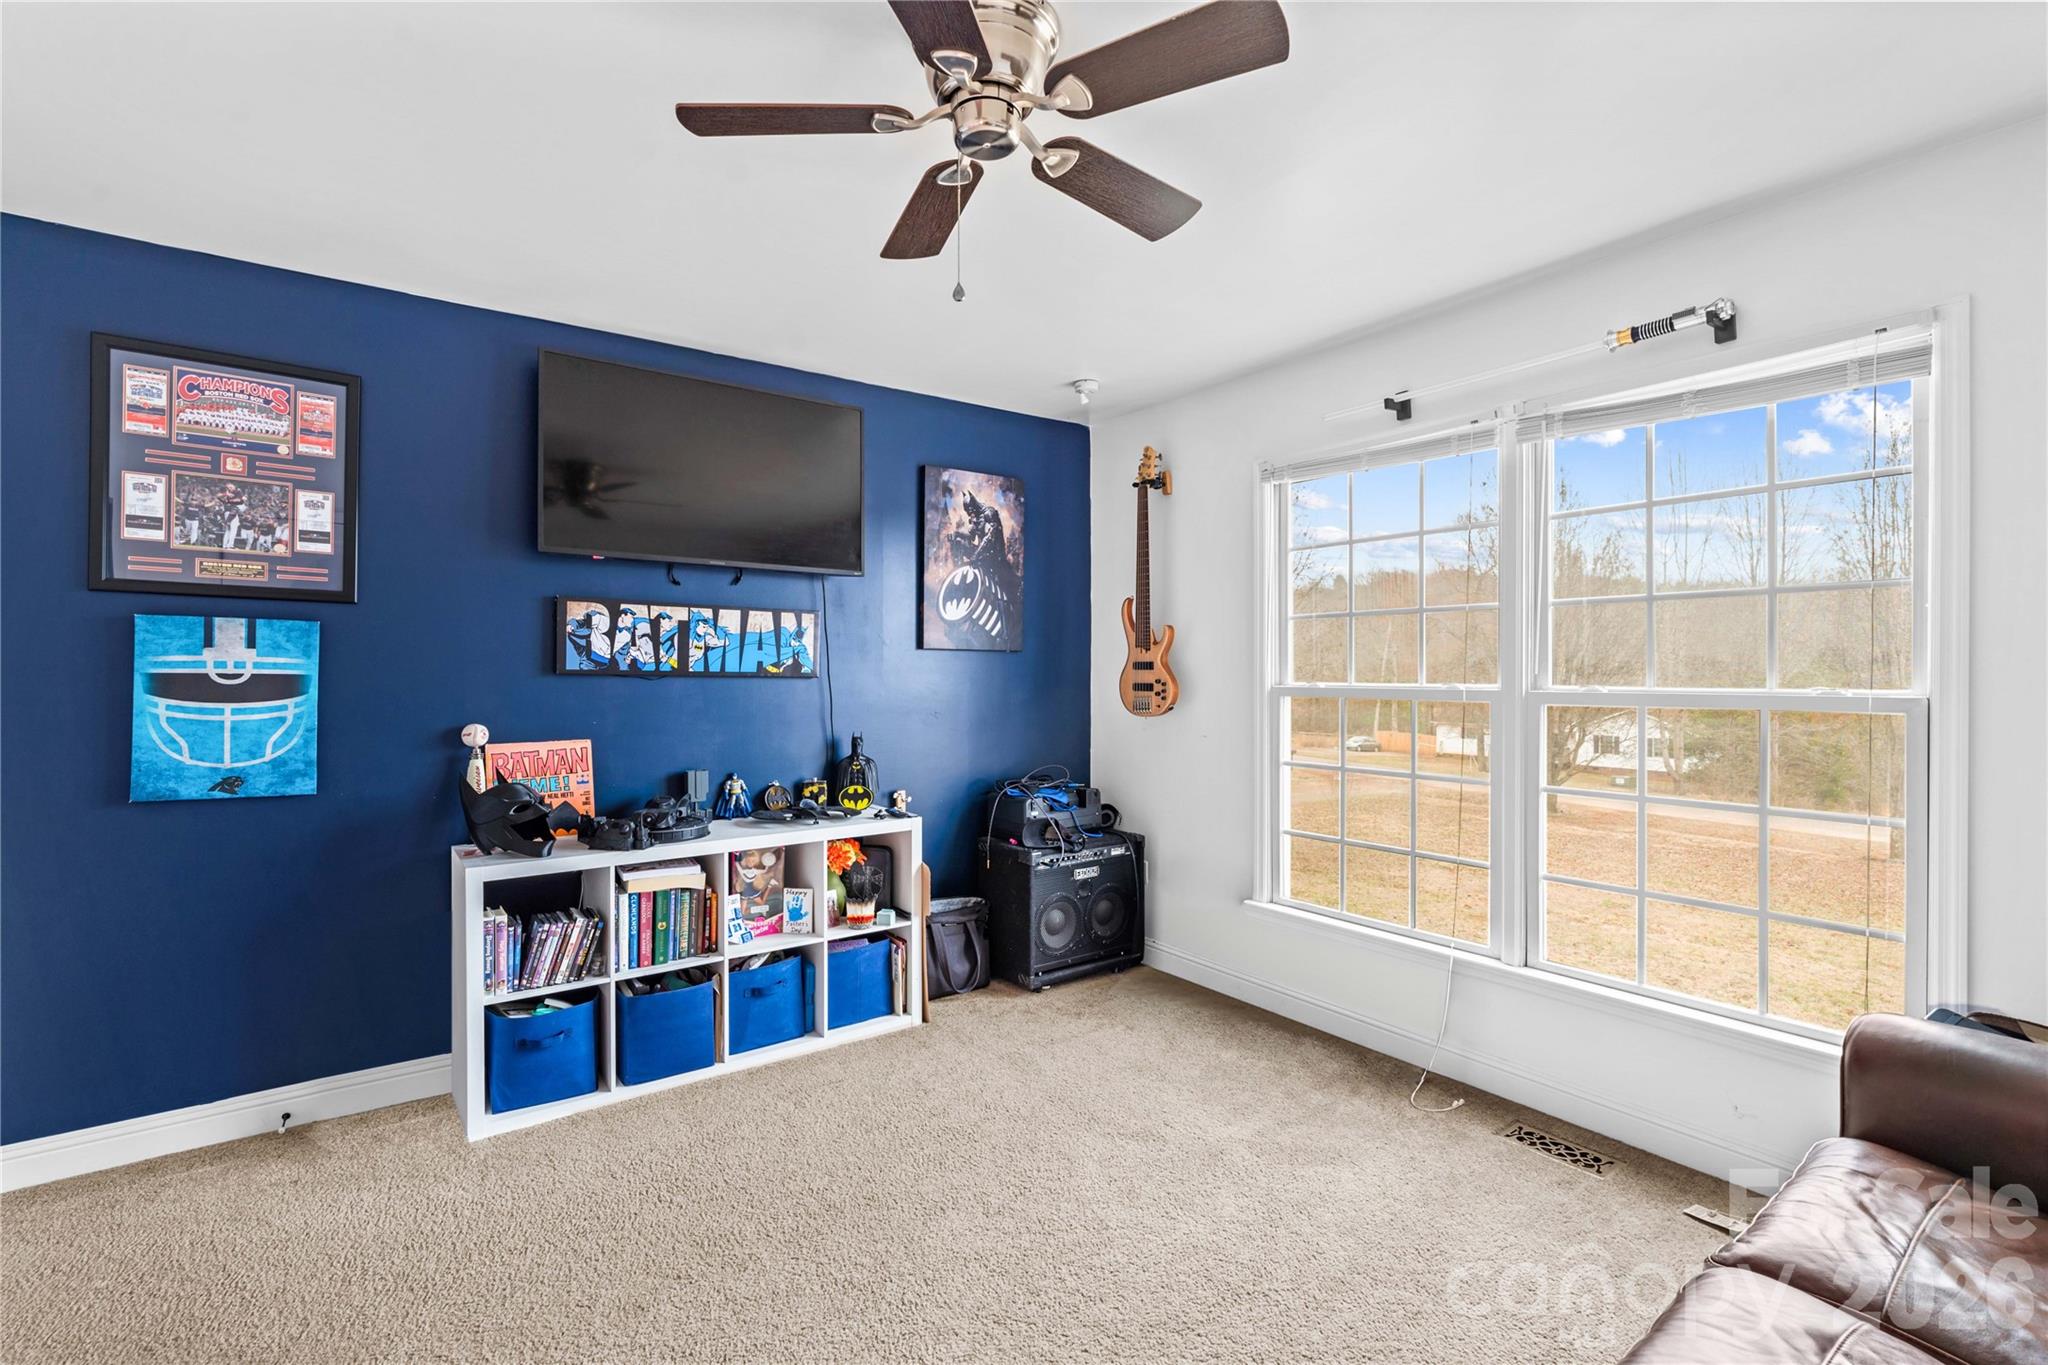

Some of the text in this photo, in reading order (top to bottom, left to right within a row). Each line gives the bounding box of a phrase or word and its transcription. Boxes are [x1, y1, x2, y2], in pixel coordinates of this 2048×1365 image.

[178, 375, 289, 414] CHAMPIONS
[204, 390, 234, 398] BOSTON
[250, 395, 264, 403] SOX
[565, 600, 815, 674] BATMAN
[491, 747, 589, 779] BATMAN
[785, 889, 808, 897] Happy
[630, 894, 638, 935] CLANLANDS
